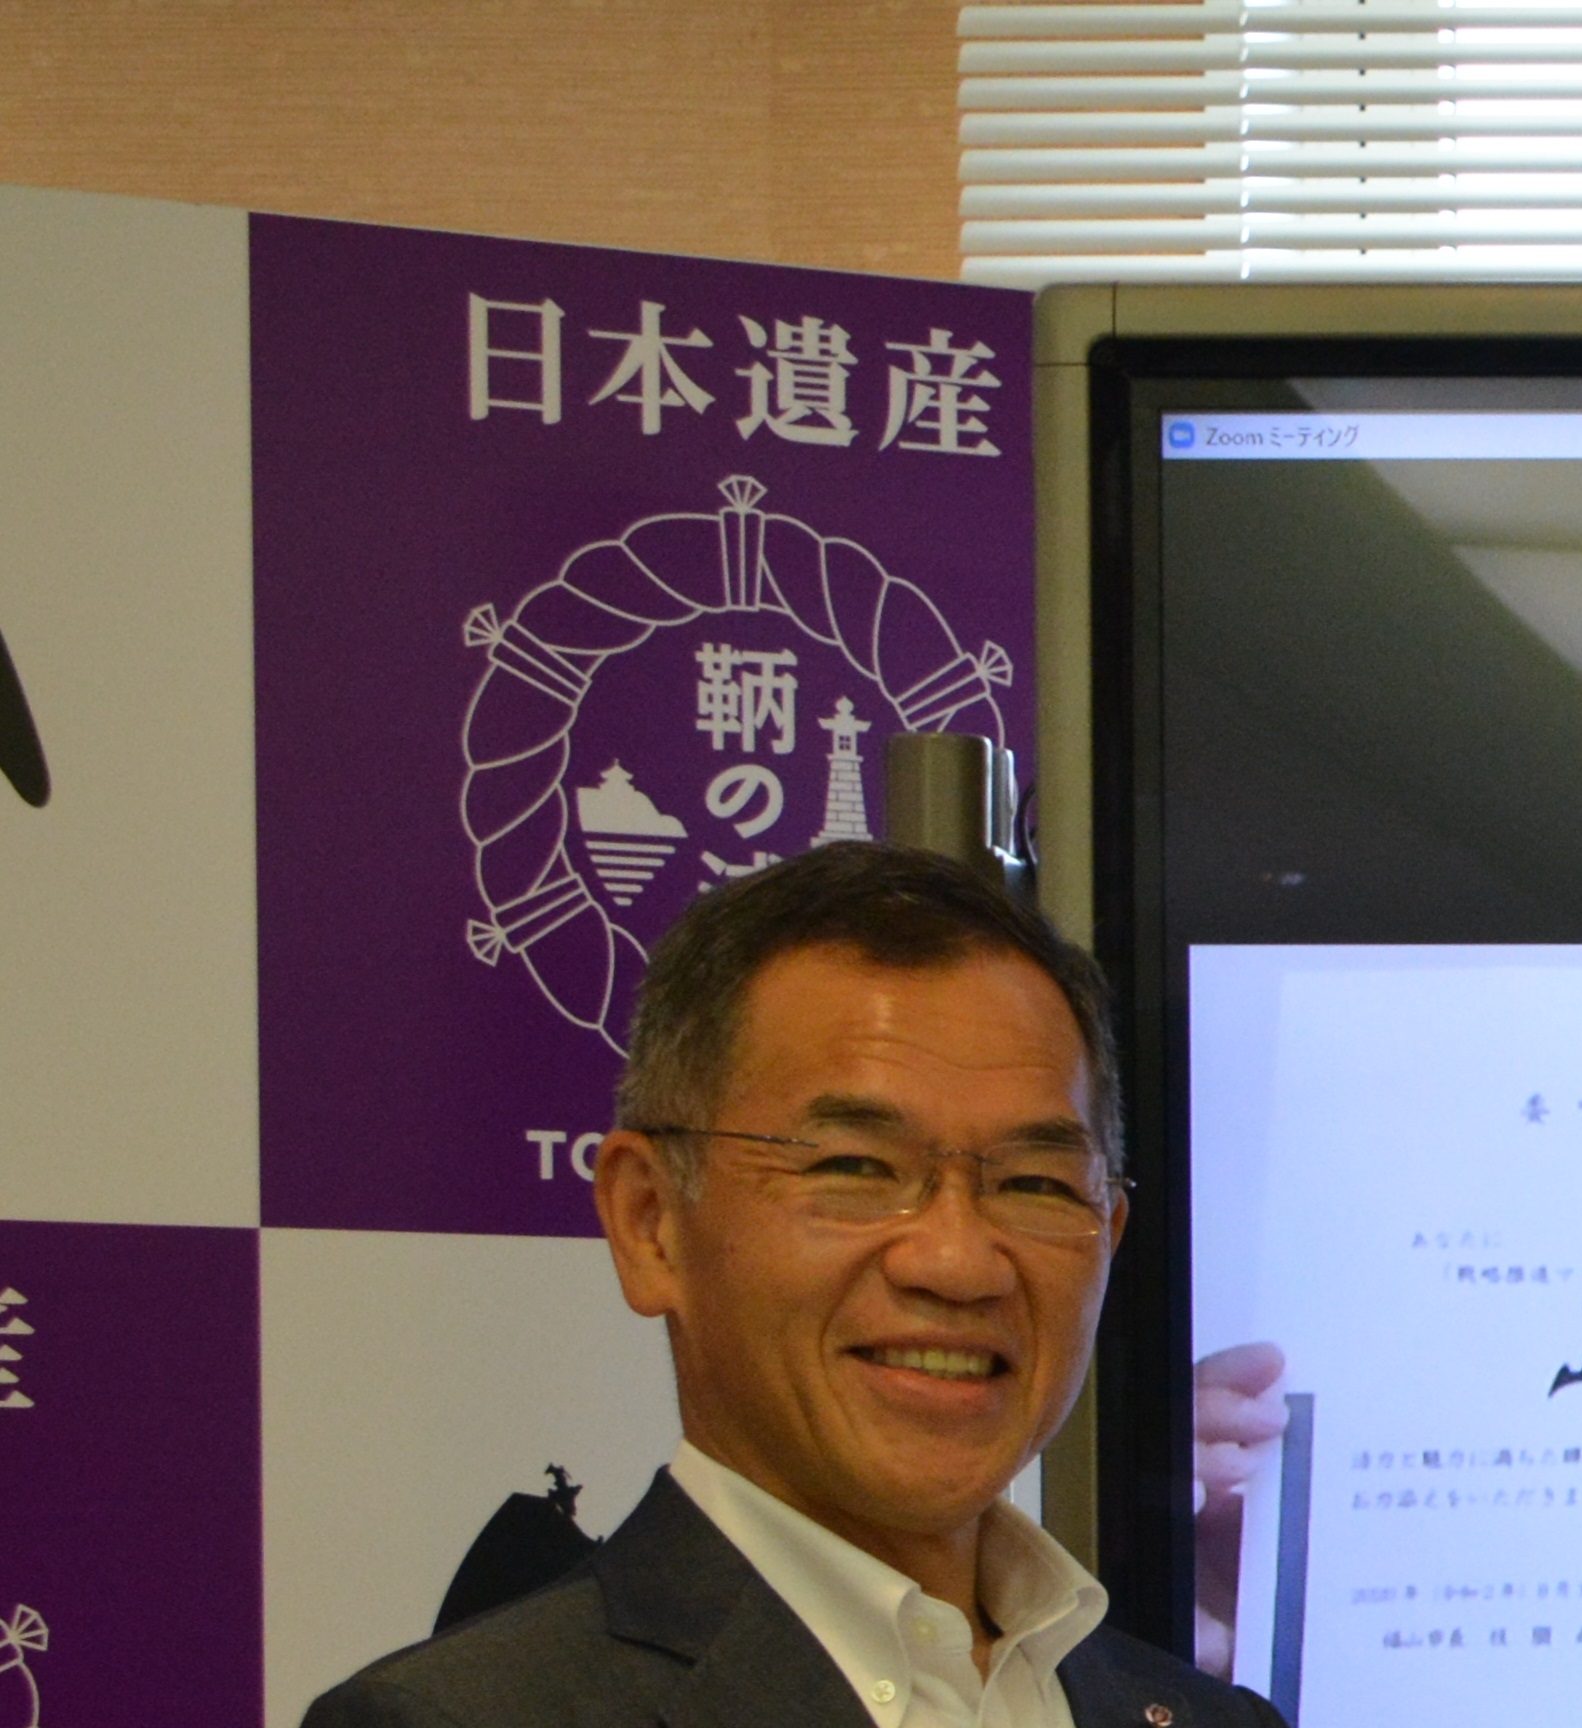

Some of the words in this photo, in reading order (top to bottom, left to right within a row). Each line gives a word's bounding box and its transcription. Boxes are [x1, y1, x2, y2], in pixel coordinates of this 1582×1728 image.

[468, 292, 1002, 457] 日本遺産
[1206, 426, 1264, 447] Zoom
[1269, 424, 1361, 448] ミーティング
